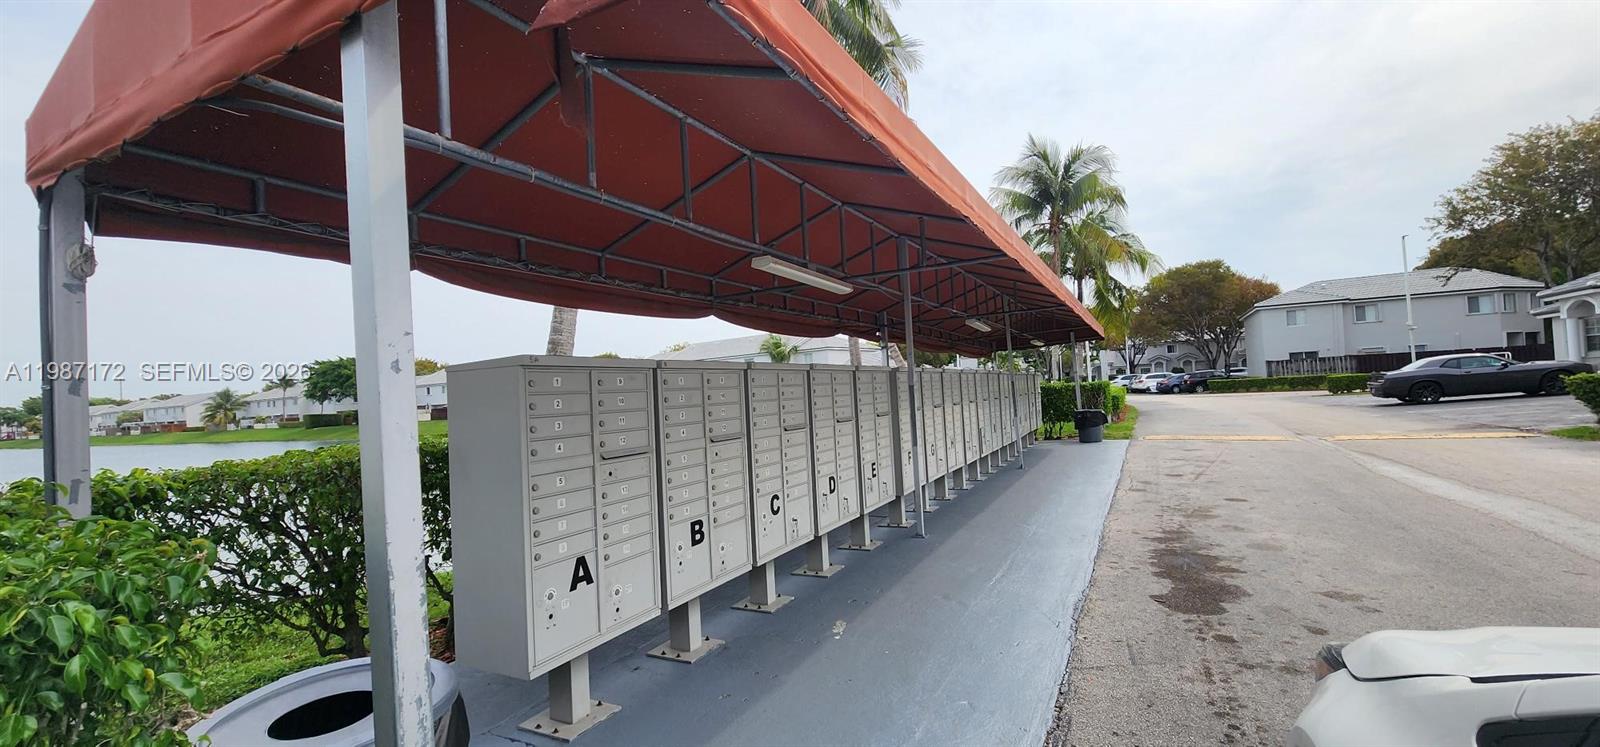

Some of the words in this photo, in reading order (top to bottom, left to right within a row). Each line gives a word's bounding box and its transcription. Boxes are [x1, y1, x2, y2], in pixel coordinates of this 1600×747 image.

[871, 462, 877, 478] E
[828, 475, 836, 494] D
[770, 494, 780, 516] C
[690, 519, 705, 547] B
[569, 555, 594, 592] A
